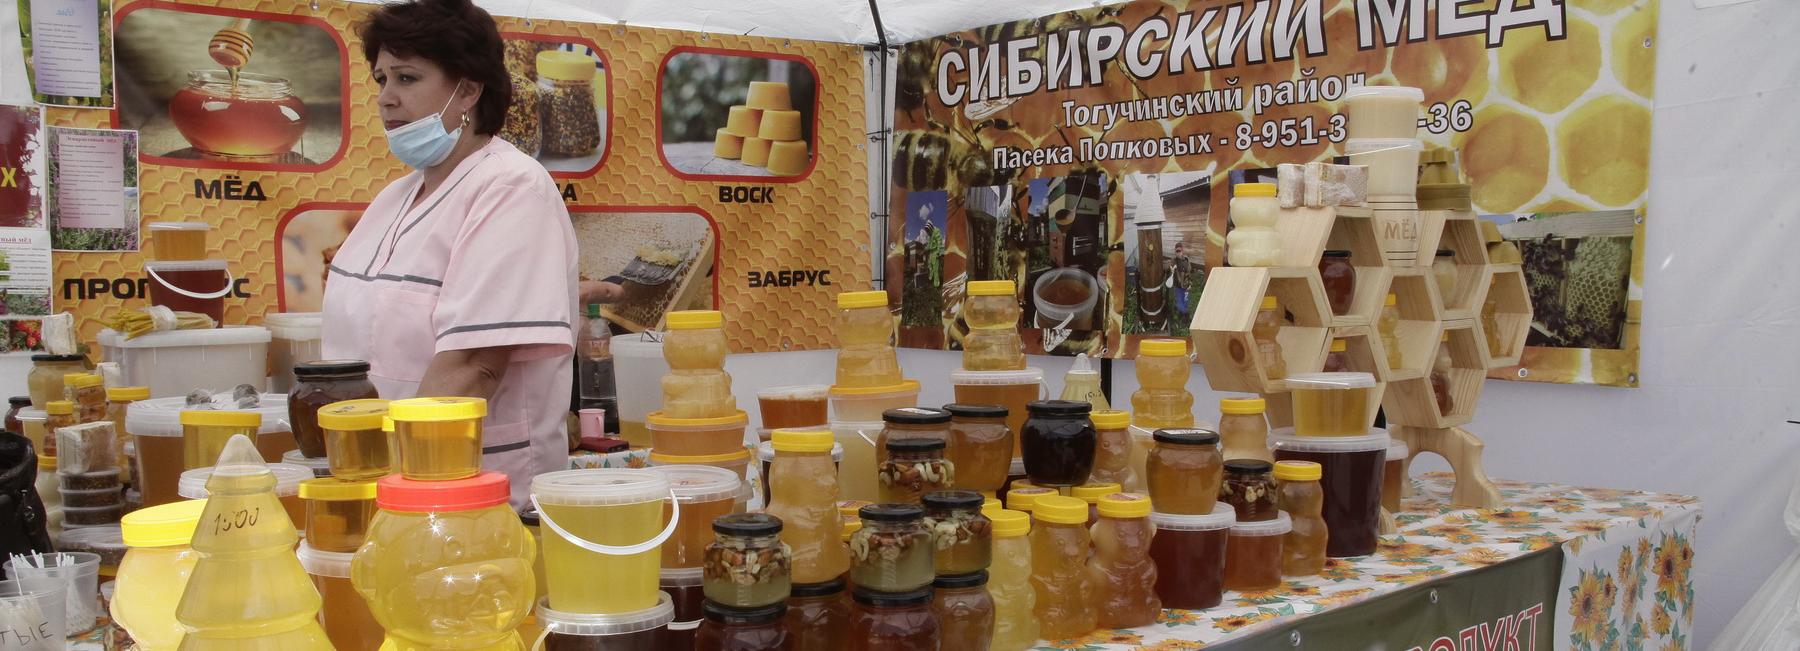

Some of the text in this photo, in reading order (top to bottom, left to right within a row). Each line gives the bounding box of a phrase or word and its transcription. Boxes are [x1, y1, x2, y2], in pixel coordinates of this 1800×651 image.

[1062, 68, 1367, 131] Тогучинский район
[993, 146, 1073, 170] Пасека
[1080, 132, 1212, 162] Попковых
[194, 175, 267, 201] МЁД
[719, 185, 774, 204] ВОСК
[748, 269, 832, 288] ЗАБРУС
